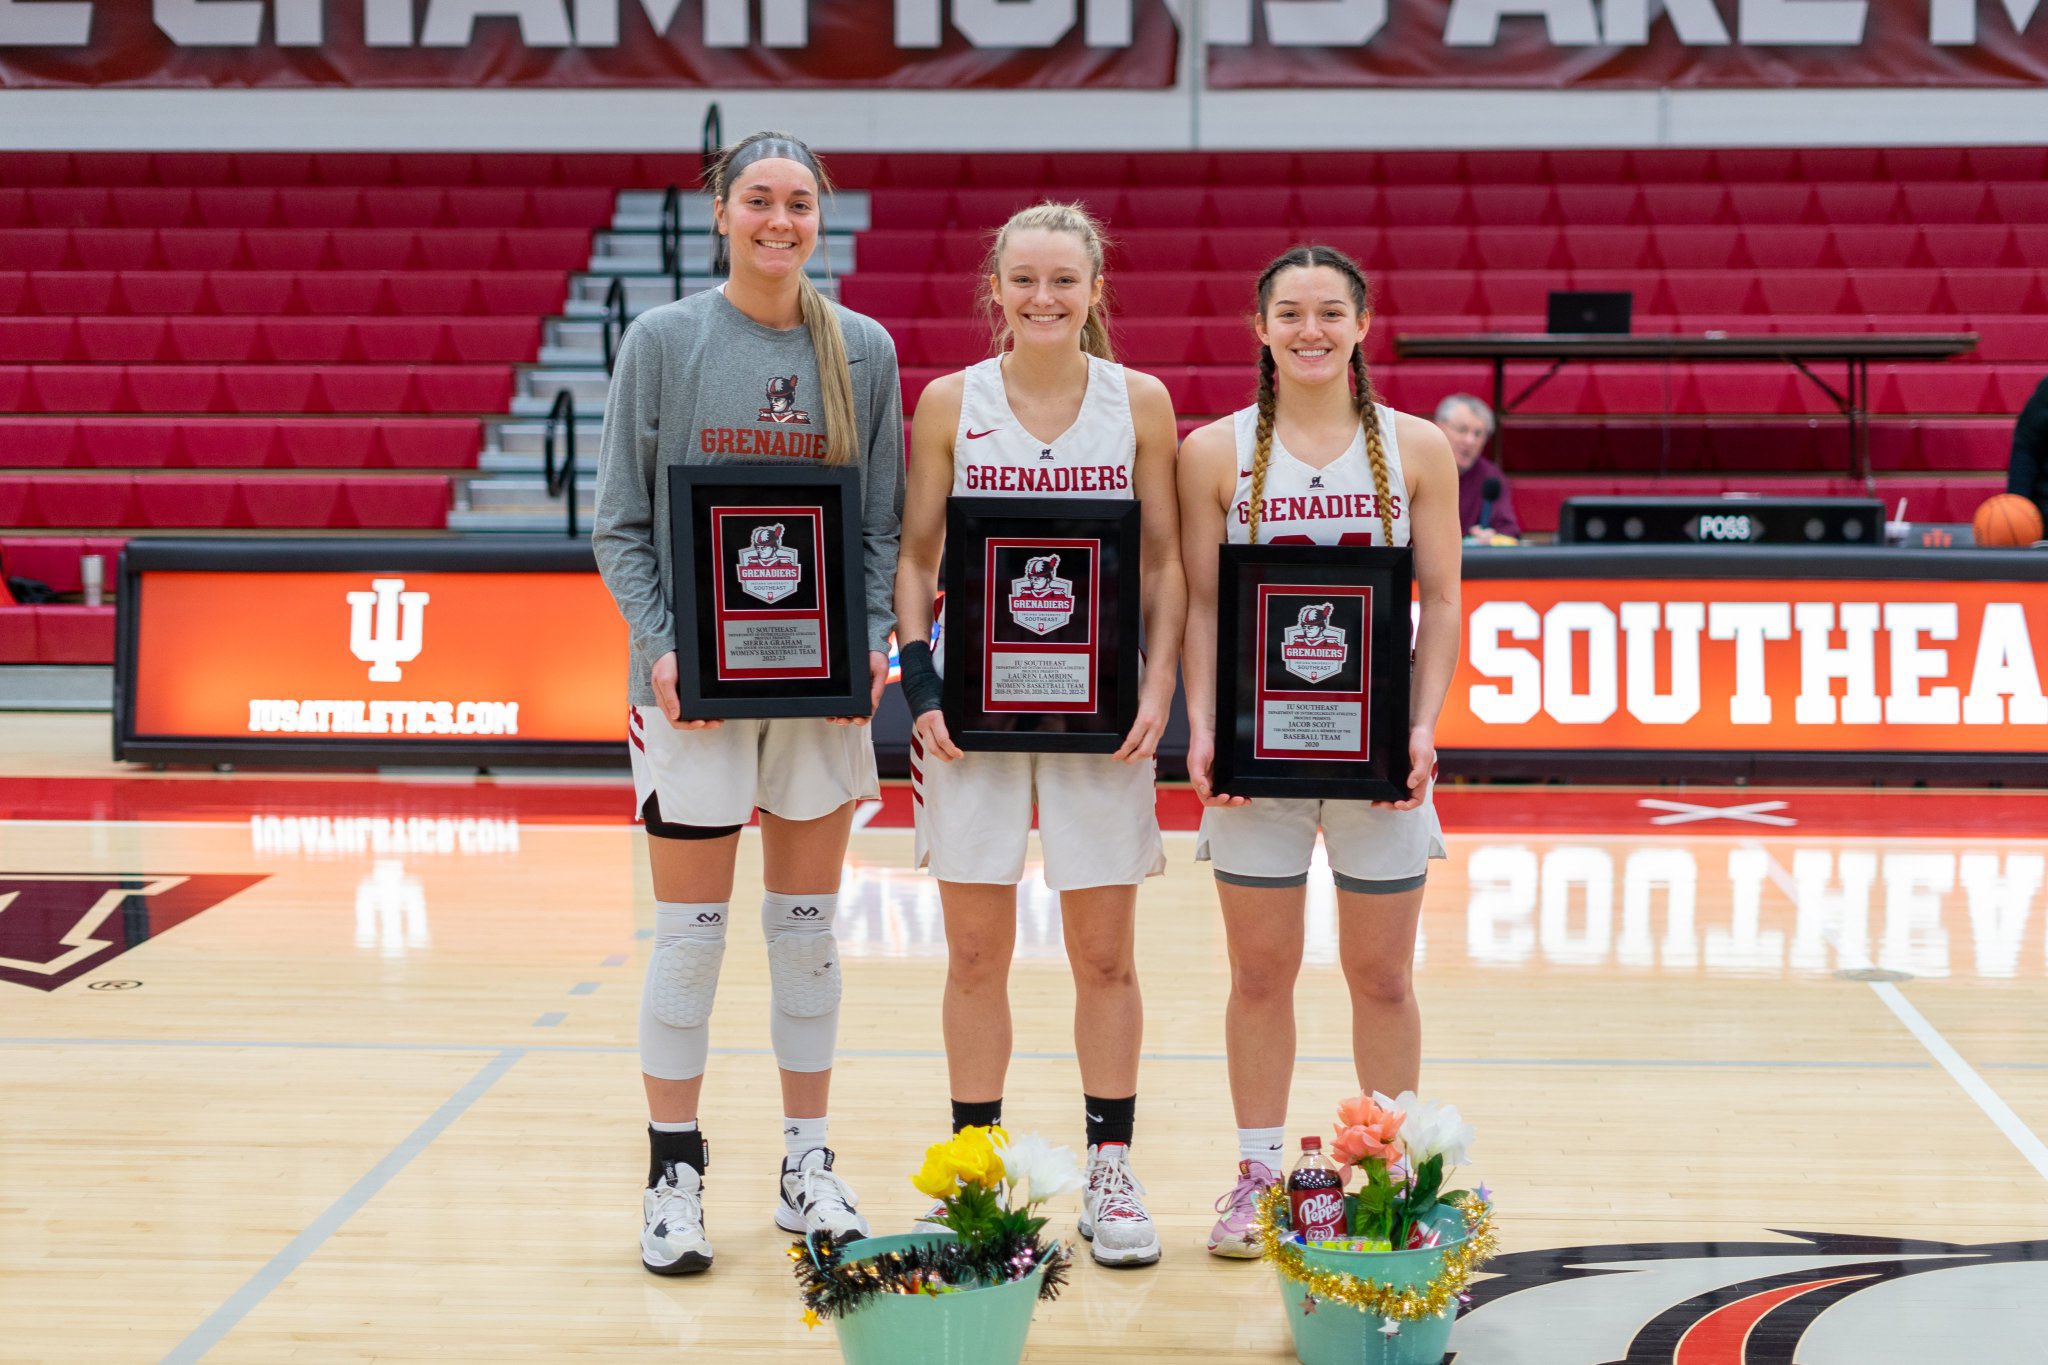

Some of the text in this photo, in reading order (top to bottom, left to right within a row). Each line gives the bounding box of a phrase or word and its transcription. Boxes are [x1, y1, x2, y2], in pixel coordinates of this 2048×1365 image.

[966, 464, 1129, 492] GRENADIERS
[1700, 515, 1751, 540] POSS
[741, 569, 797, 578] GRENADIERS
[1013, 599, 1070, 609] GRENADIERS
[1286, 647, 1343, 658] GRENADIERS
[1316, 1193, 1334, 1209] Dr
[1305, 1199, 1343, 1225] Pepper
[1313, 1229, 1325, 1240] 23
